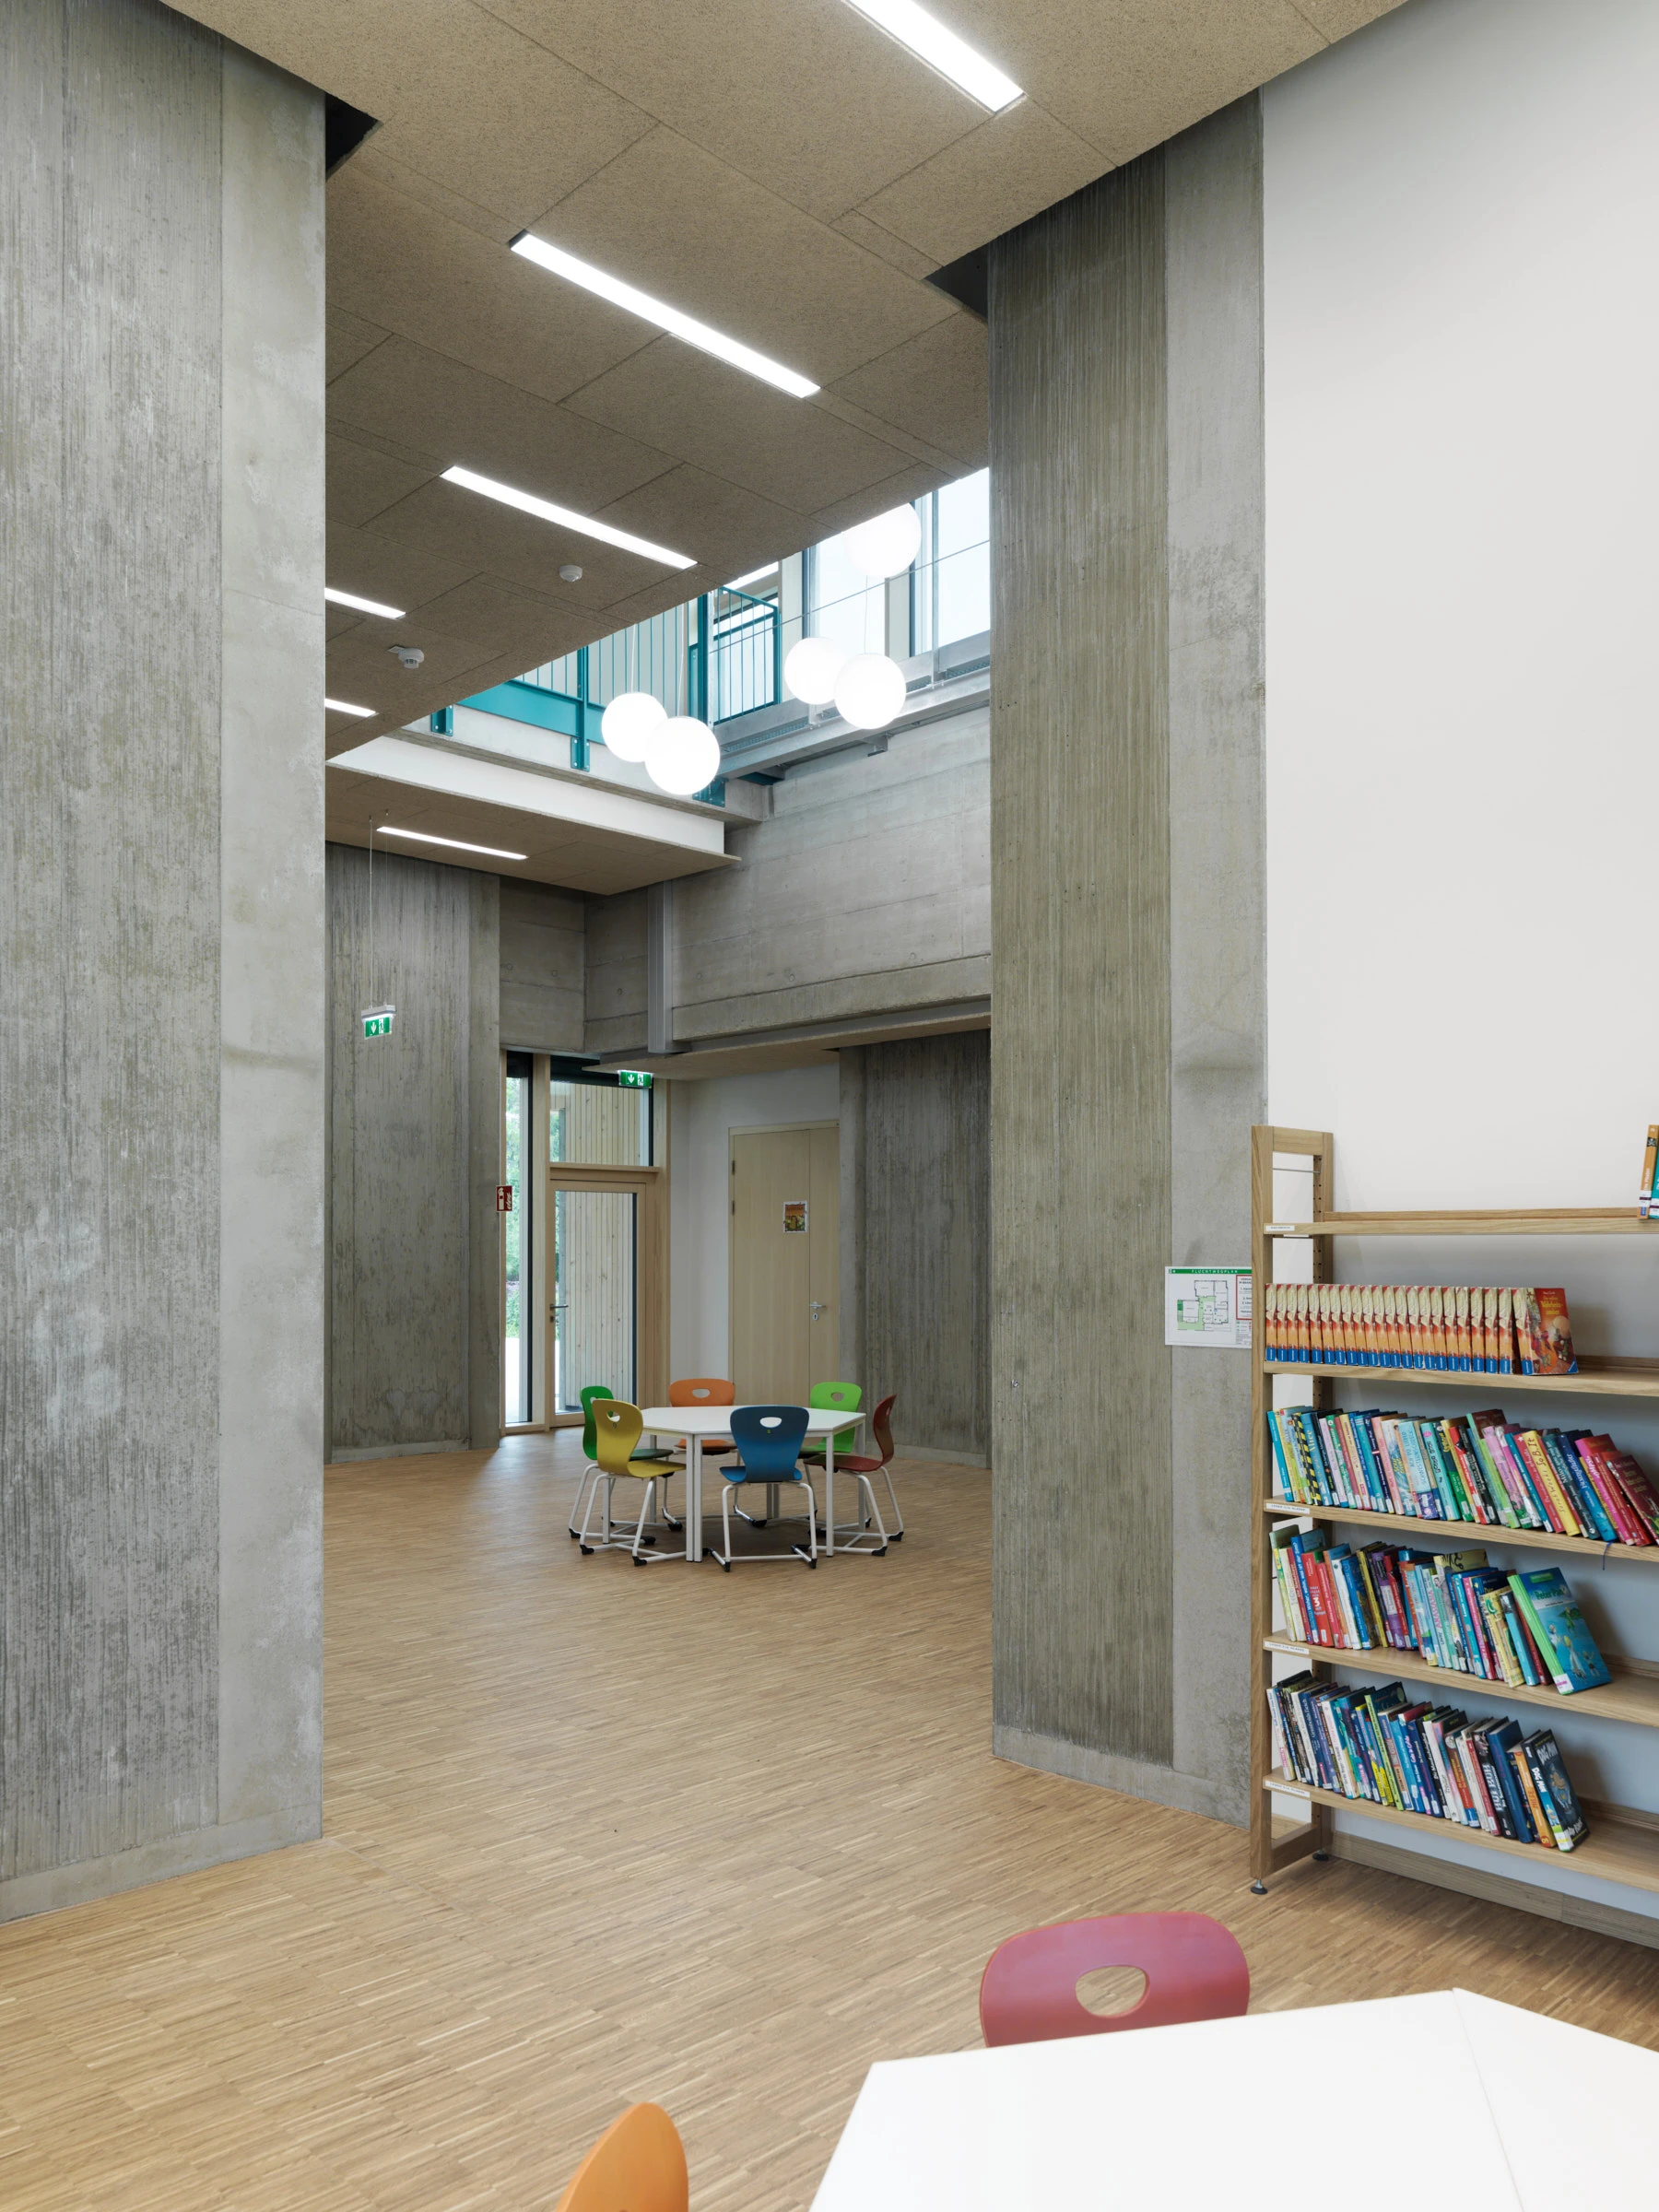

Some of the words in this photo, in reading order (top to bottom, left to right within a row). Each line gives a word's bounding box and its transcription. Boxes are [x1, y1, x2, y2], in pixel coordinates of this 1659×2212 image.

[1305, 1429, 1316, 1452] Alice
[1312, 1597, 1321, 1607] 3
[1428, 1589, 1442, 1629] ANASTASIA
[1481, 1762, 1495, 1789] BUH
[1532, 1766, 1542, 1781] DOG
[1536, 1779, 1547, 1793] MAN
[1489, 1789, 1502, 1812] HUI
